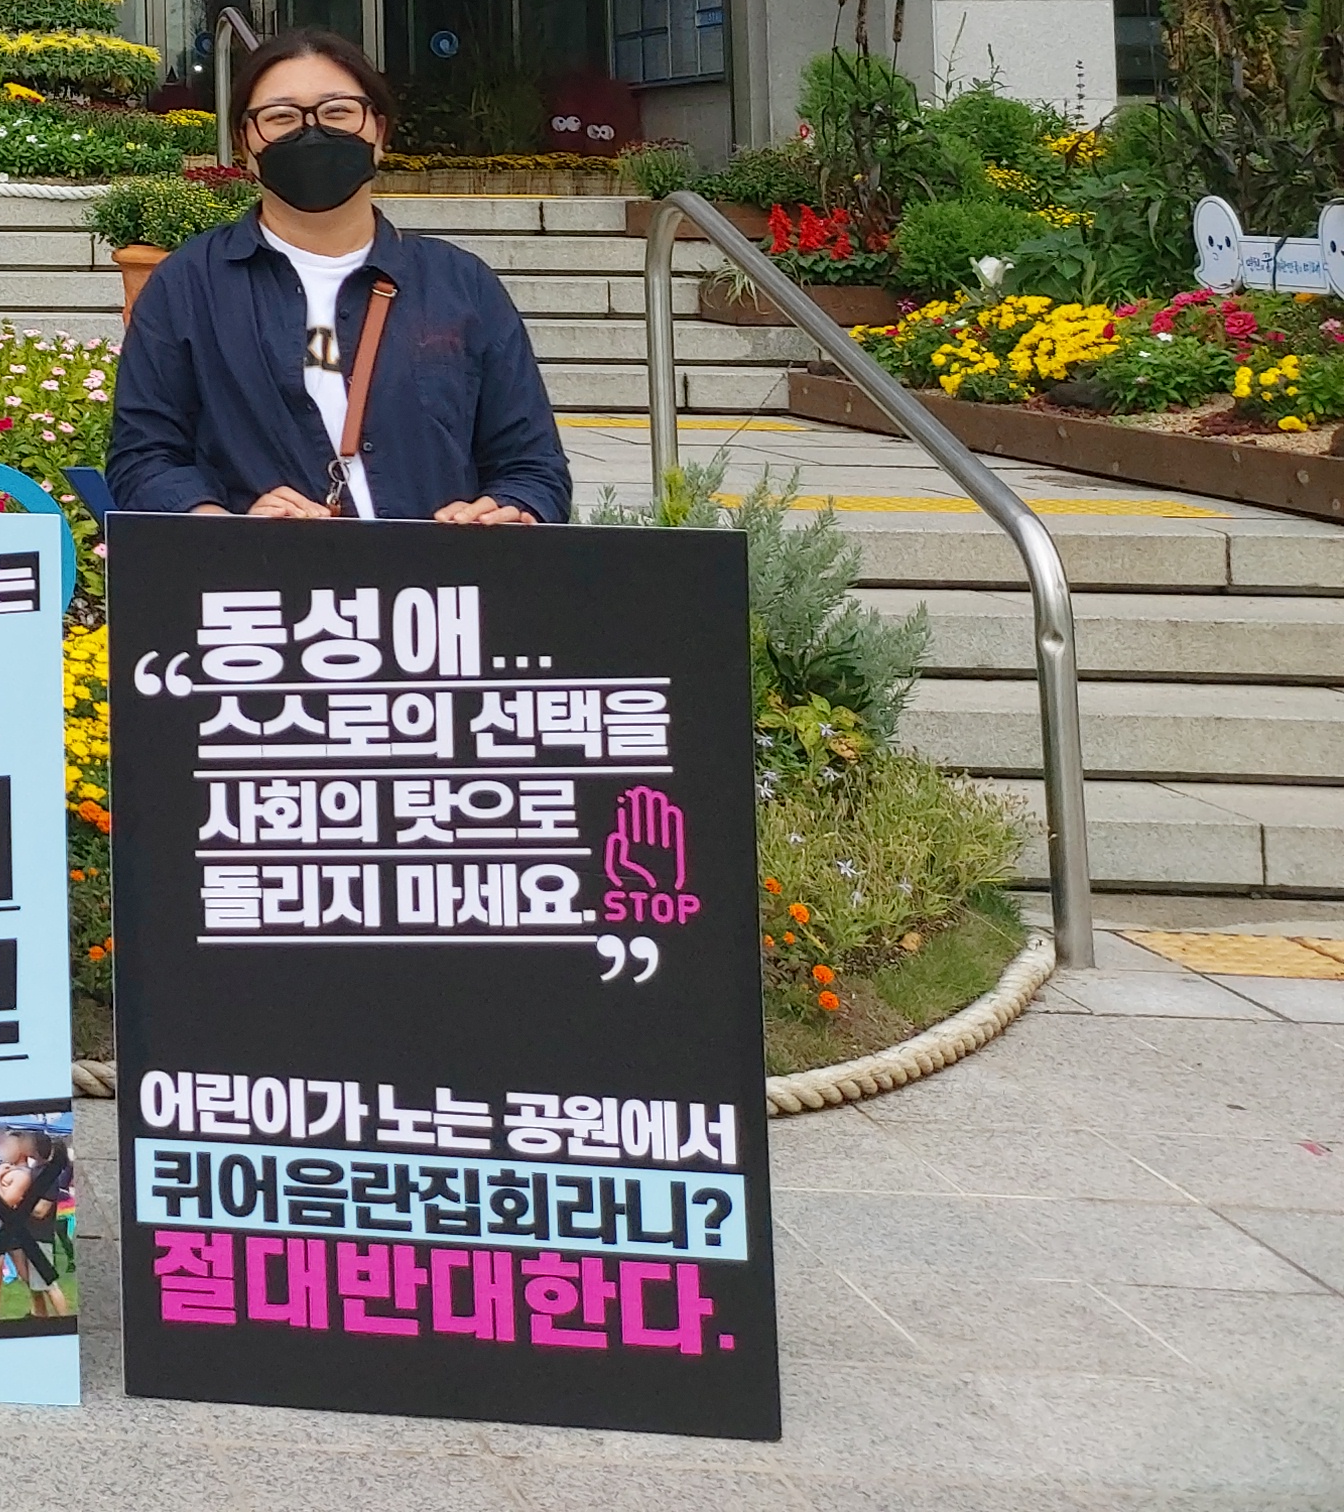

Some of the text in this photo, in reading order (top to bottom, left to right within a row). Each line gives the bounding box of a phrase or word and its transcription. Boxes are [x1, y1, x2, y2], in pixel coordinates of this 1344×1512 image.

[197, 689, 670, 759] 스스로의 선택을
[198, 780, 579, 843] 사회의 탓으로
[200, 864, 380, 929] 돌리지
[604, 890, 700, 924] STOP
[140, 1070, 737, 1164] 어린이가 노는 공원에서
[153, 1150, 733, 1249] 퀴어음란집회라니?
[153, 1229, 735, 1356] 절대반대한다.
